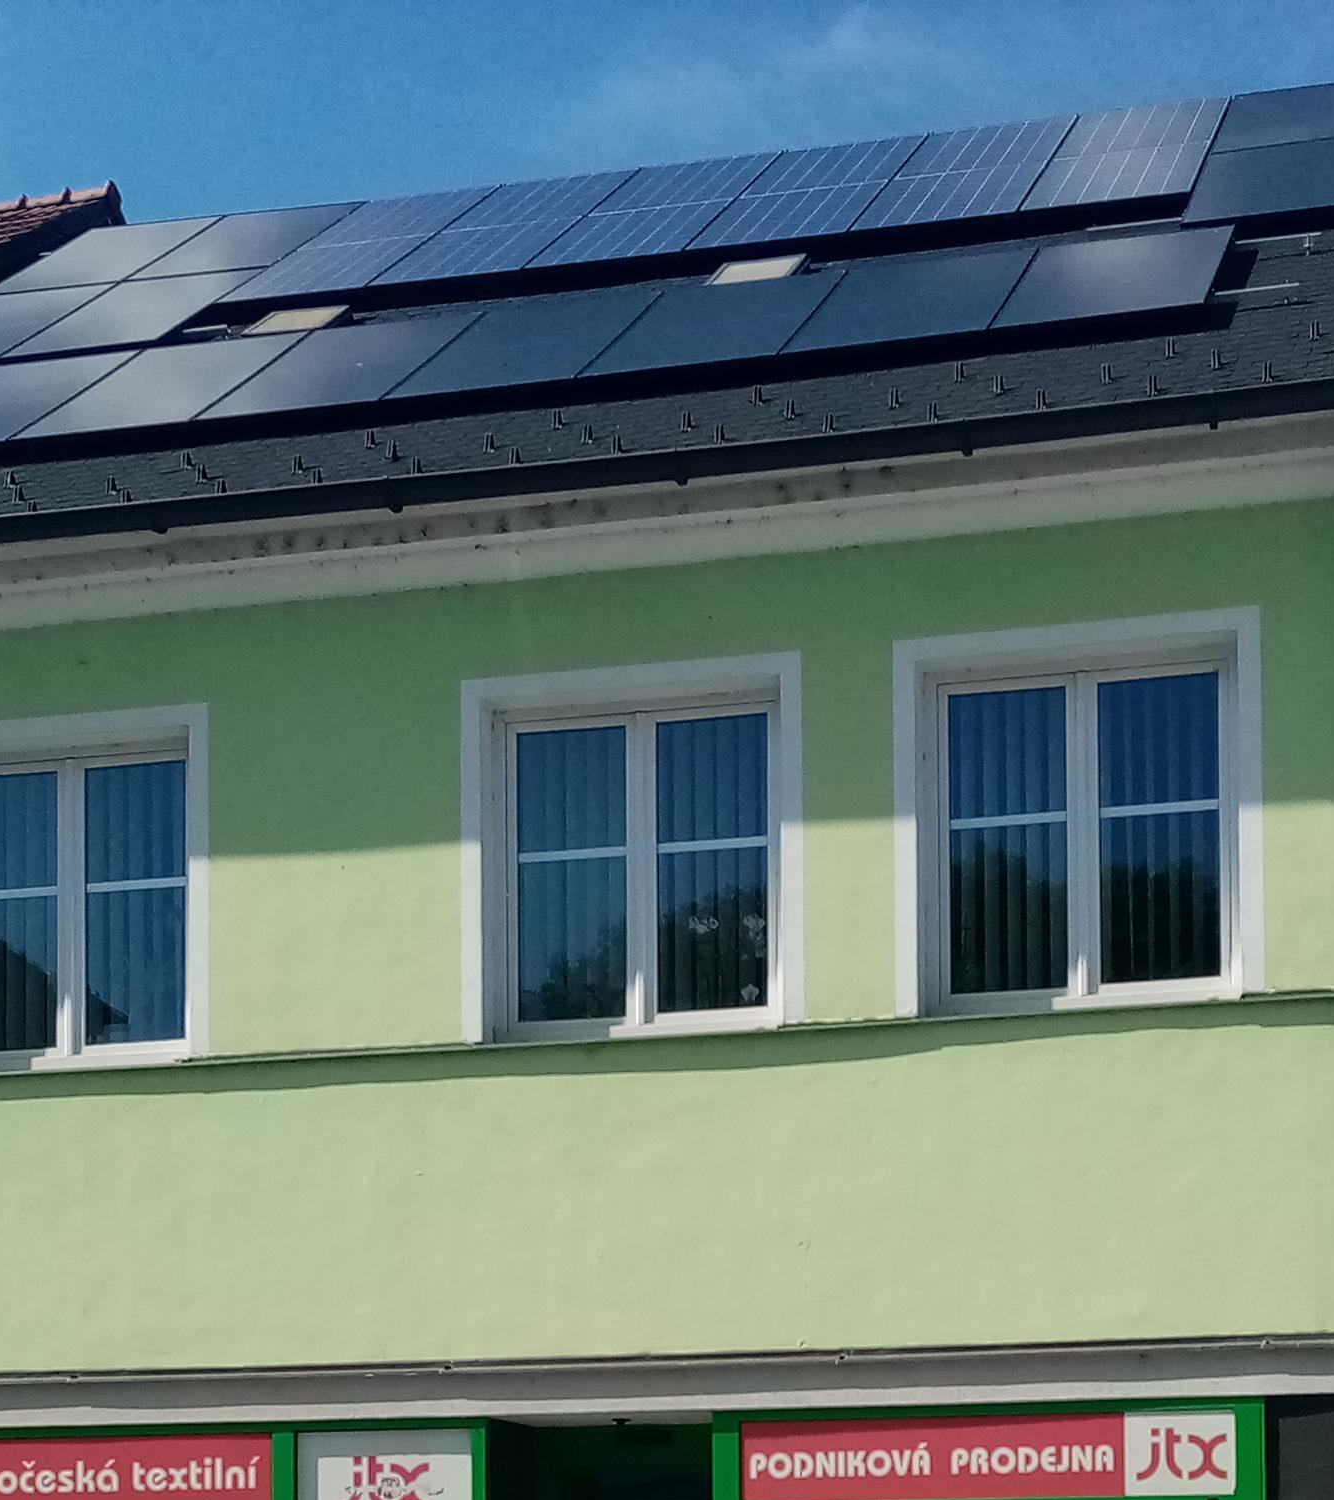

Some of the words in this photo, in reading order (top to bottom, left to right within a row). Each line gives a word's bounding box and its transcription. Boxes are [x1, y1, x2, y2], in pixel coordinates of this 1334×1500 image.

[749, 1441, 931, 1479] PODNIKOVÁ
[950, 1444, 1114, 1476] PRODEJNA
[1136, 1427, 1227, 1481] jtx
[131, 1455, 260, 1492] textilní
